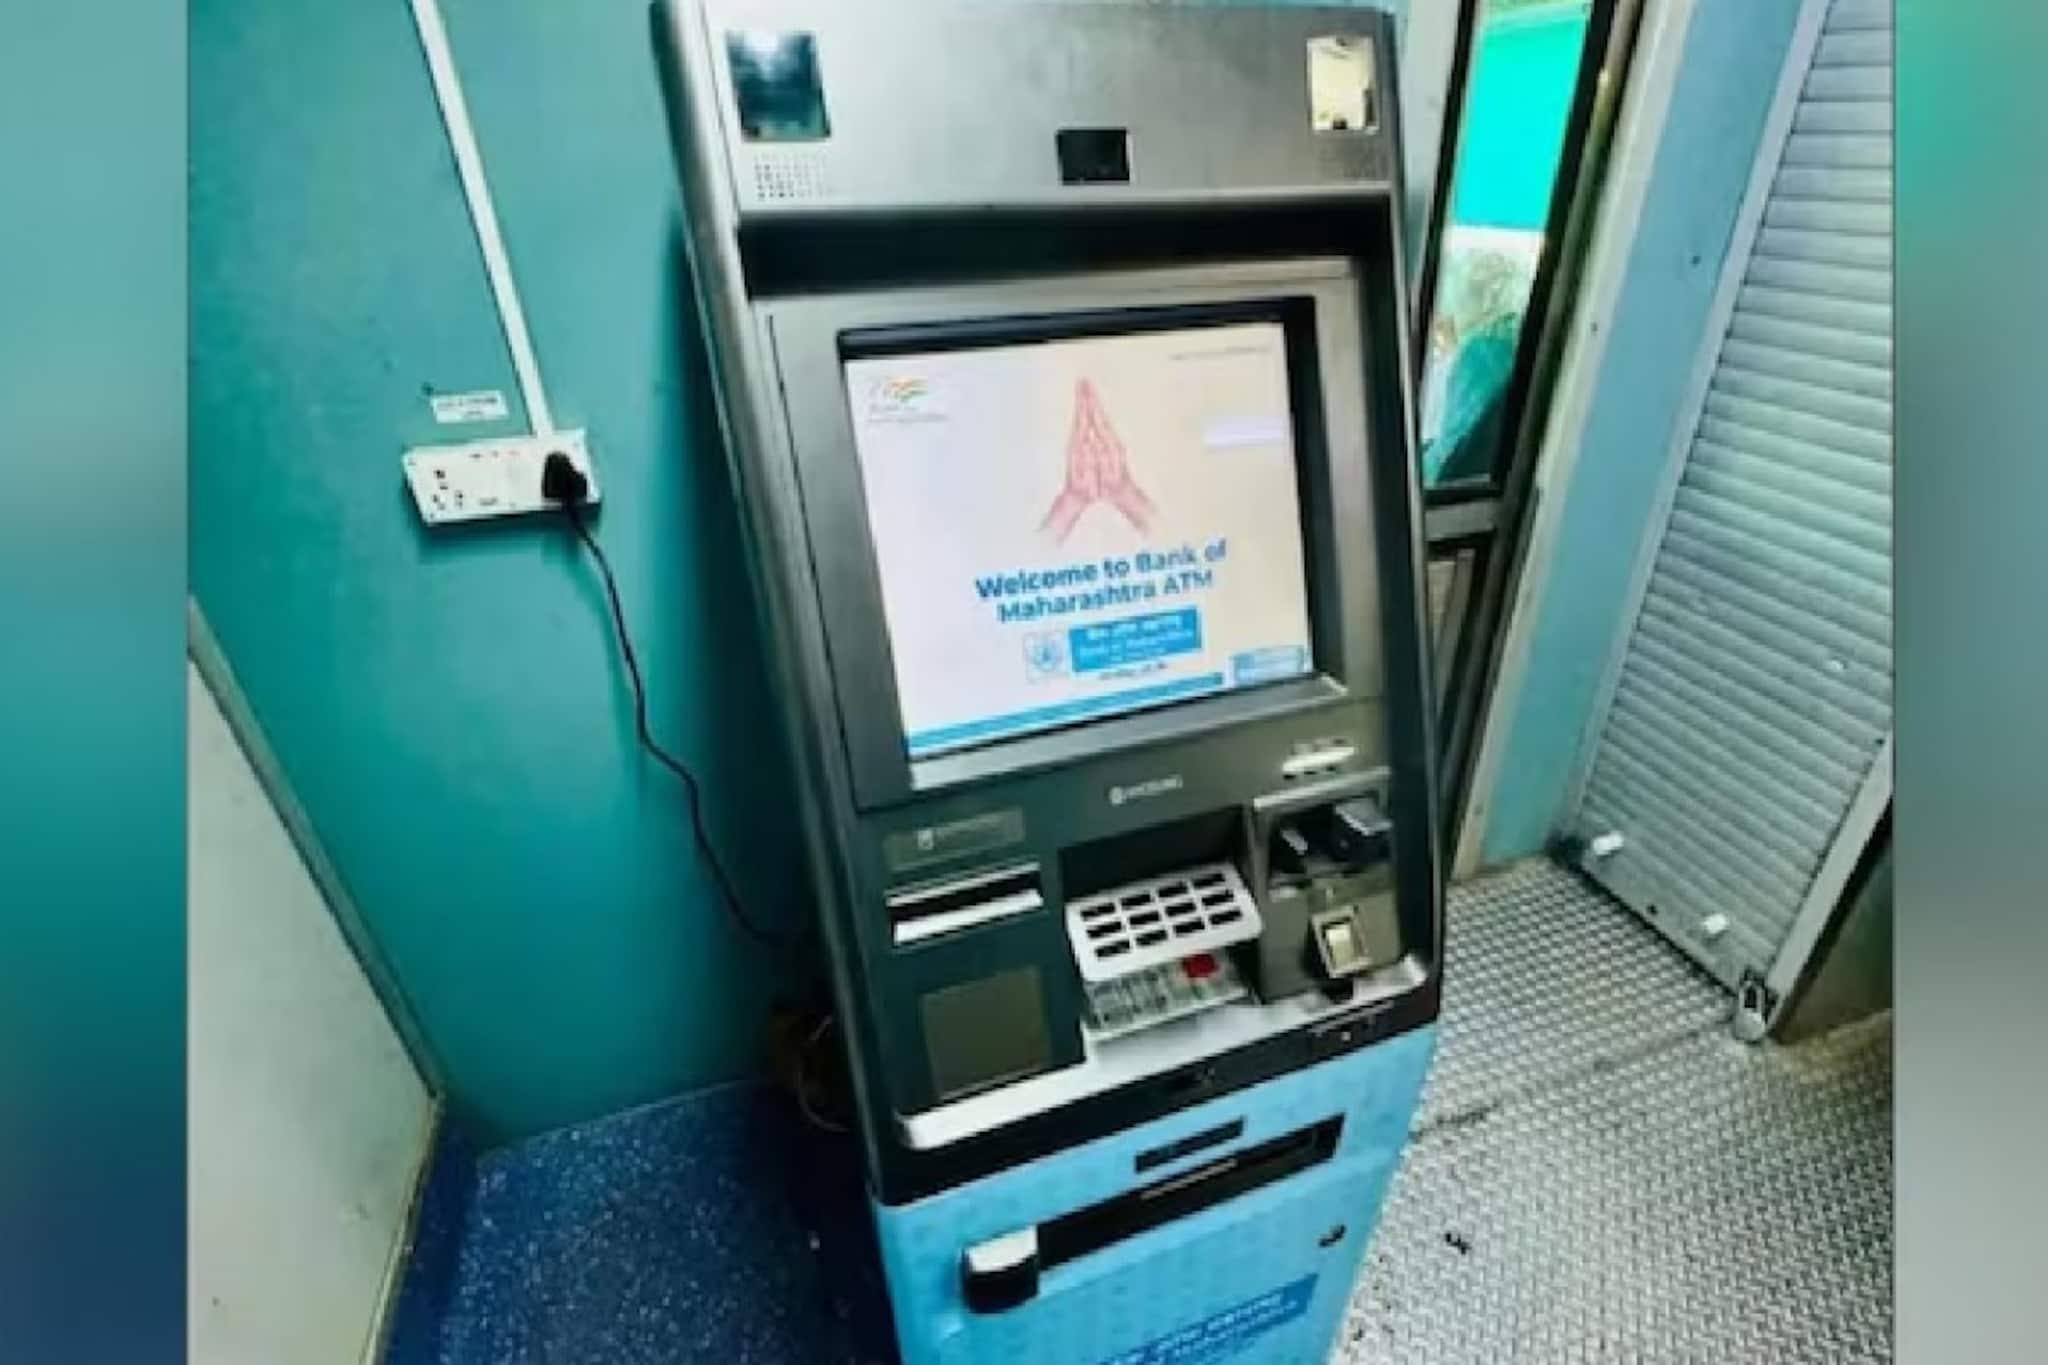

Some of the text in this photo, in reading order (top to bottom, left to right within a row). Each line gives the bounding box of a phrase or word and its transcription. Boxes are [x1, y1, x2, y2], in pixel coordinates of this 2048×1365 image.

[975, 537, 1228, 598] Welcome to Bank of
[997, 569, 1213, 623] Maharashtra ATM
